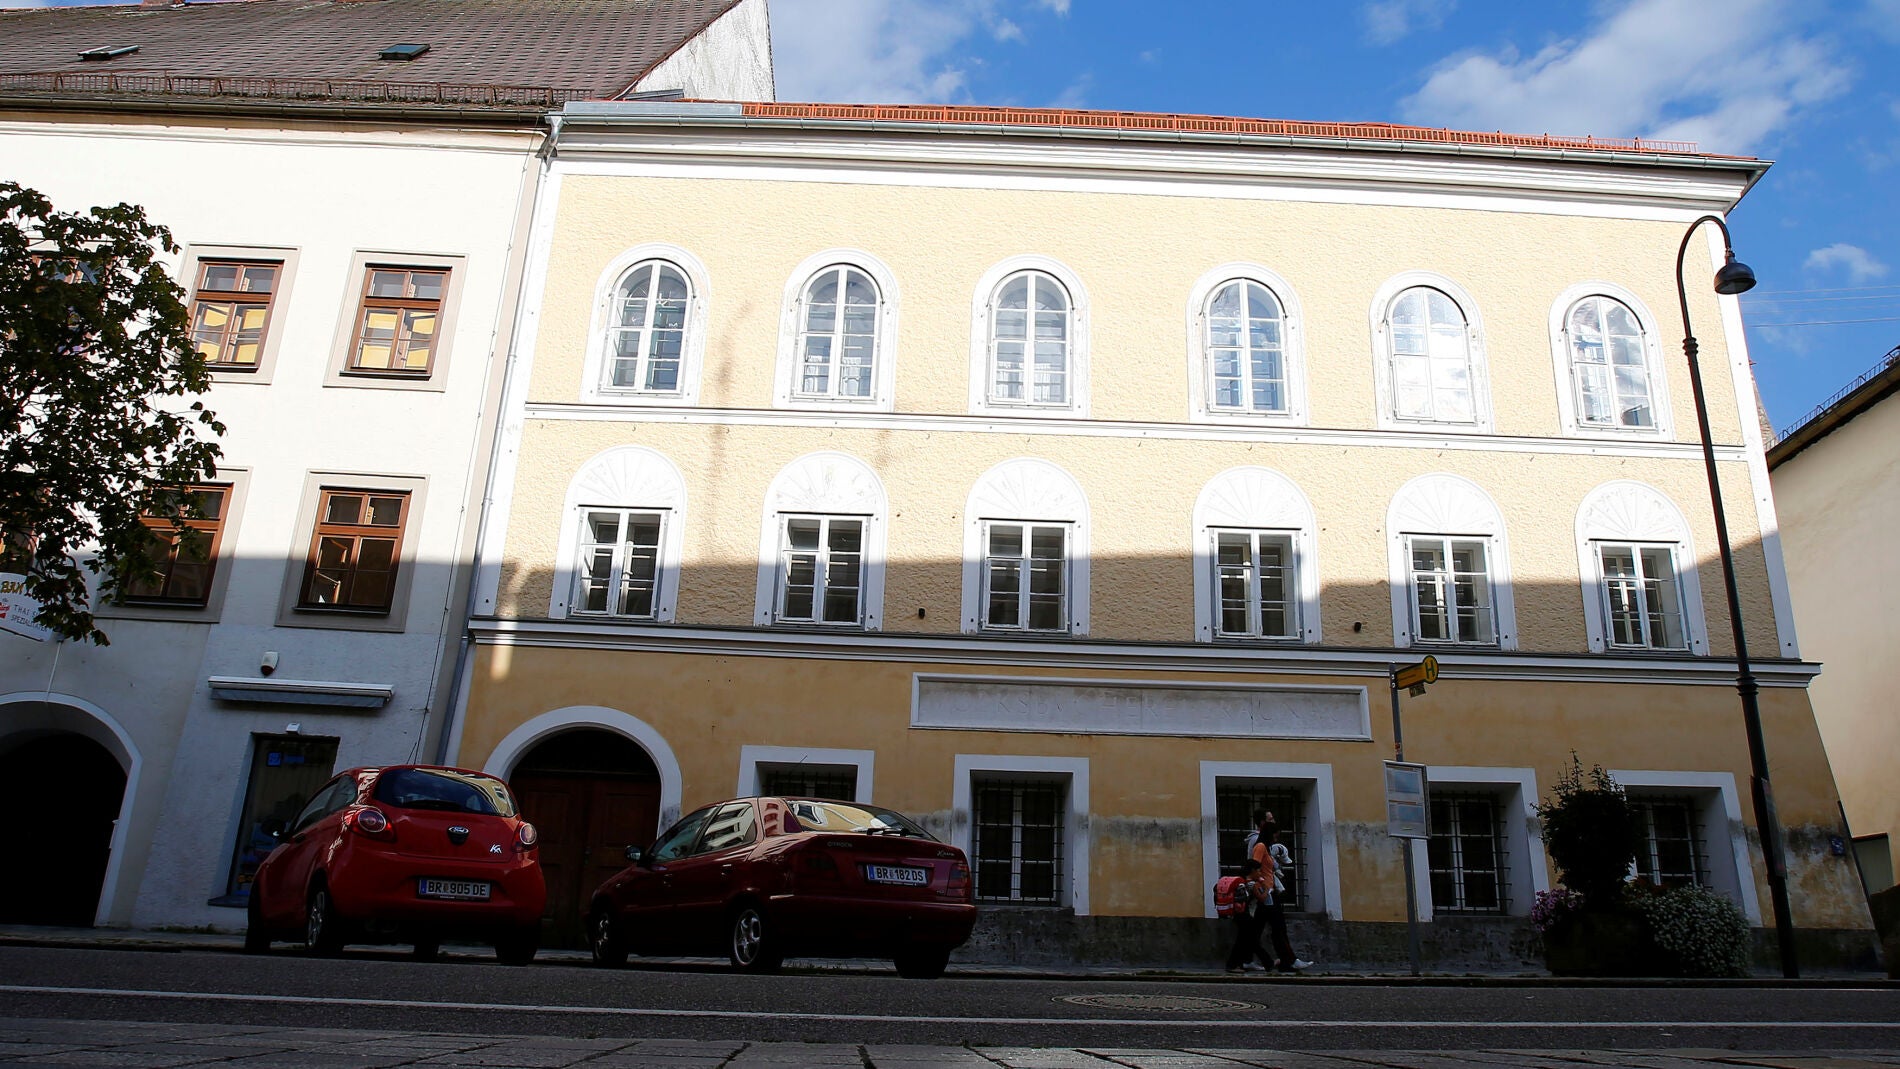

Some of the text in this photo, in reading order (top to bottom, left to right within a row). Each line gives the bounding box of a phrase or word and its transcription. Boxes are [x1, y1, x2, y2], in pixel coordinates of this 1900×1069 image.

[1425, 660, 1435, 679] H
[876, 867, 923, 882] BR 182 DS
[428, 881, 487, 896] BR 905 DE
